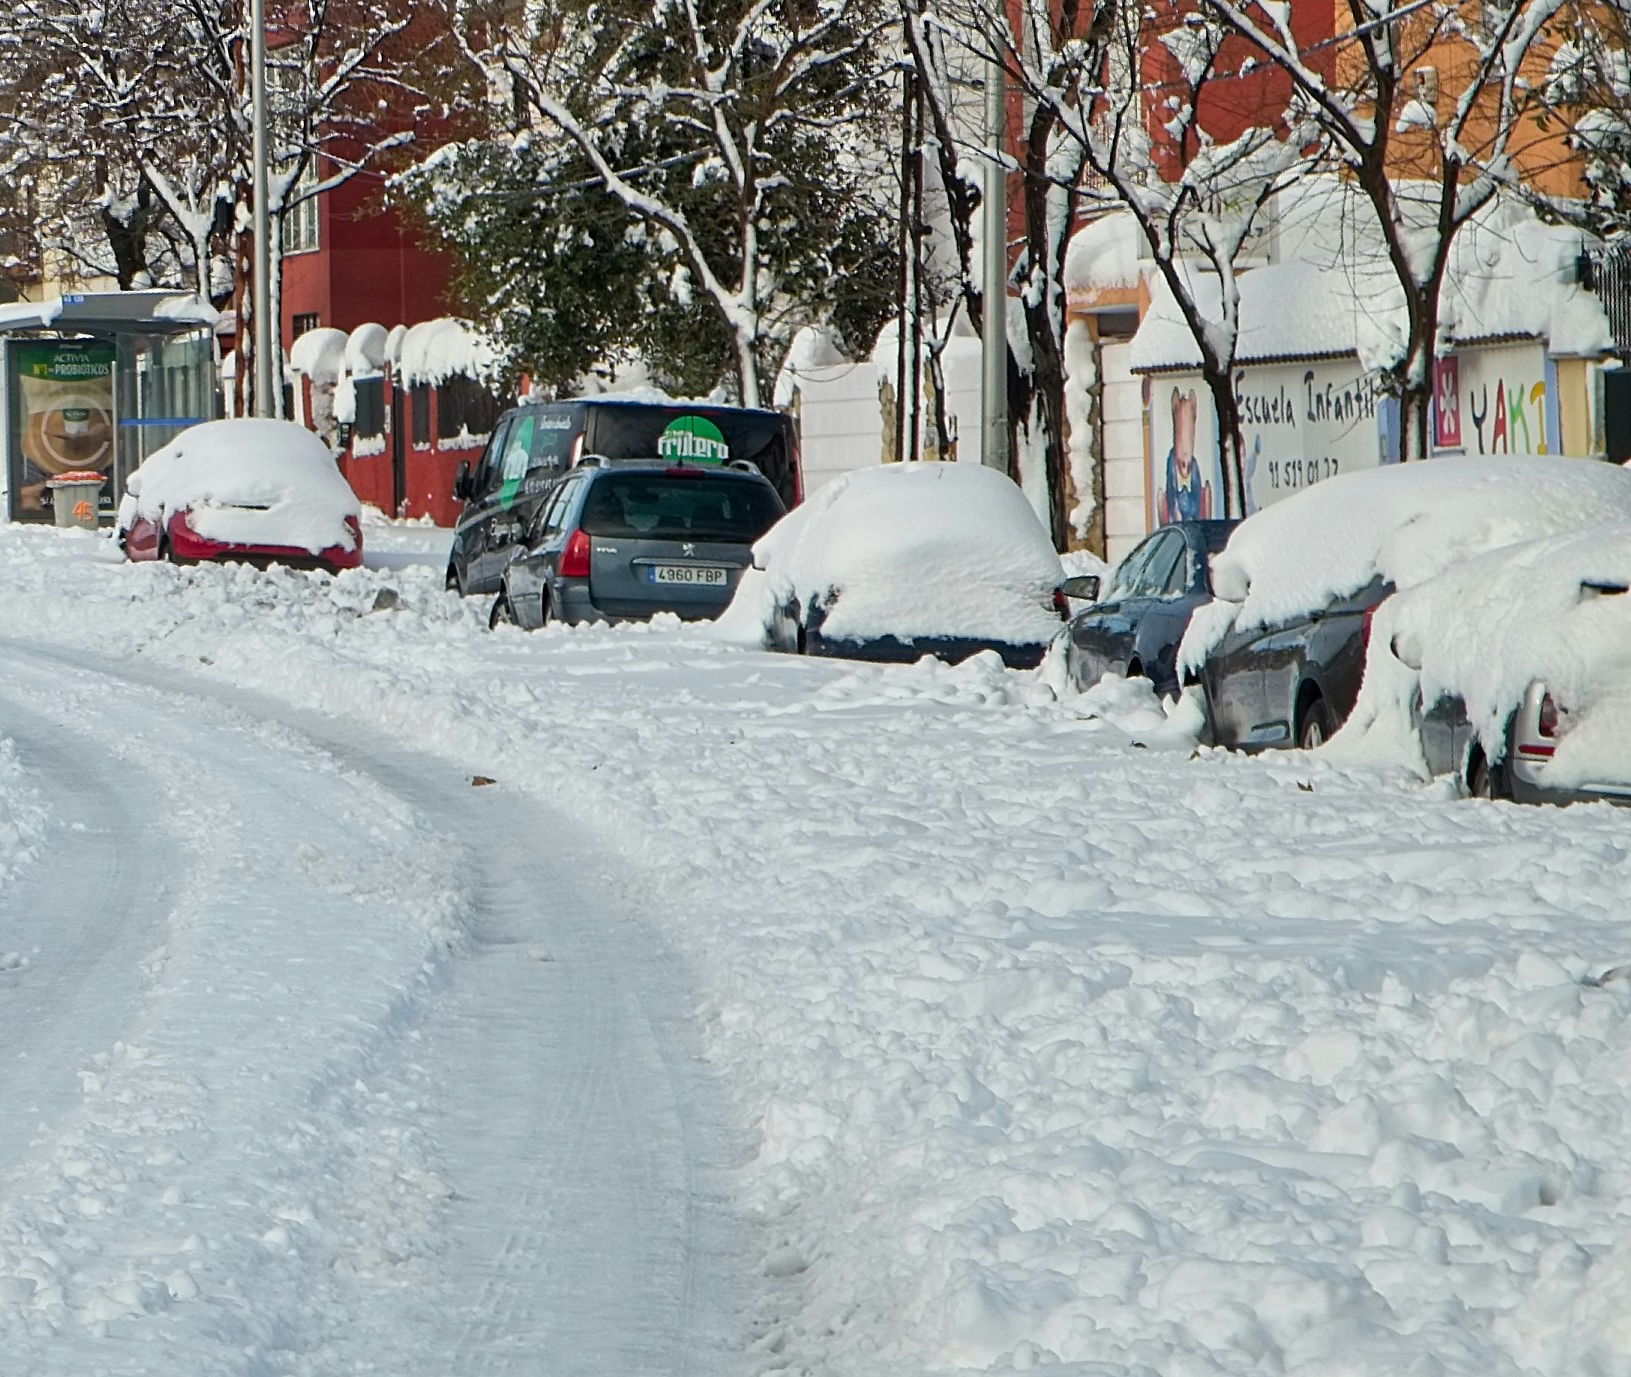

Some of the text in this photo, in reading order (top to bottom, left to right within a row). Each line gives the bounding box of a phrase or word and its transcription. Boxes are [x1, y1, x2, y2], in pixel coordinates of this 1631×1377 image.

[1235, 370, 1374, 428] Escuela Infantil
[1269, 460, 1279, 488] 91
[1284, 459, 1304, 488] 519
[1307, 458, 1319, 486] 01
[72, 500, 94, 522] 45
[658, 568, 693, 581] 4960
